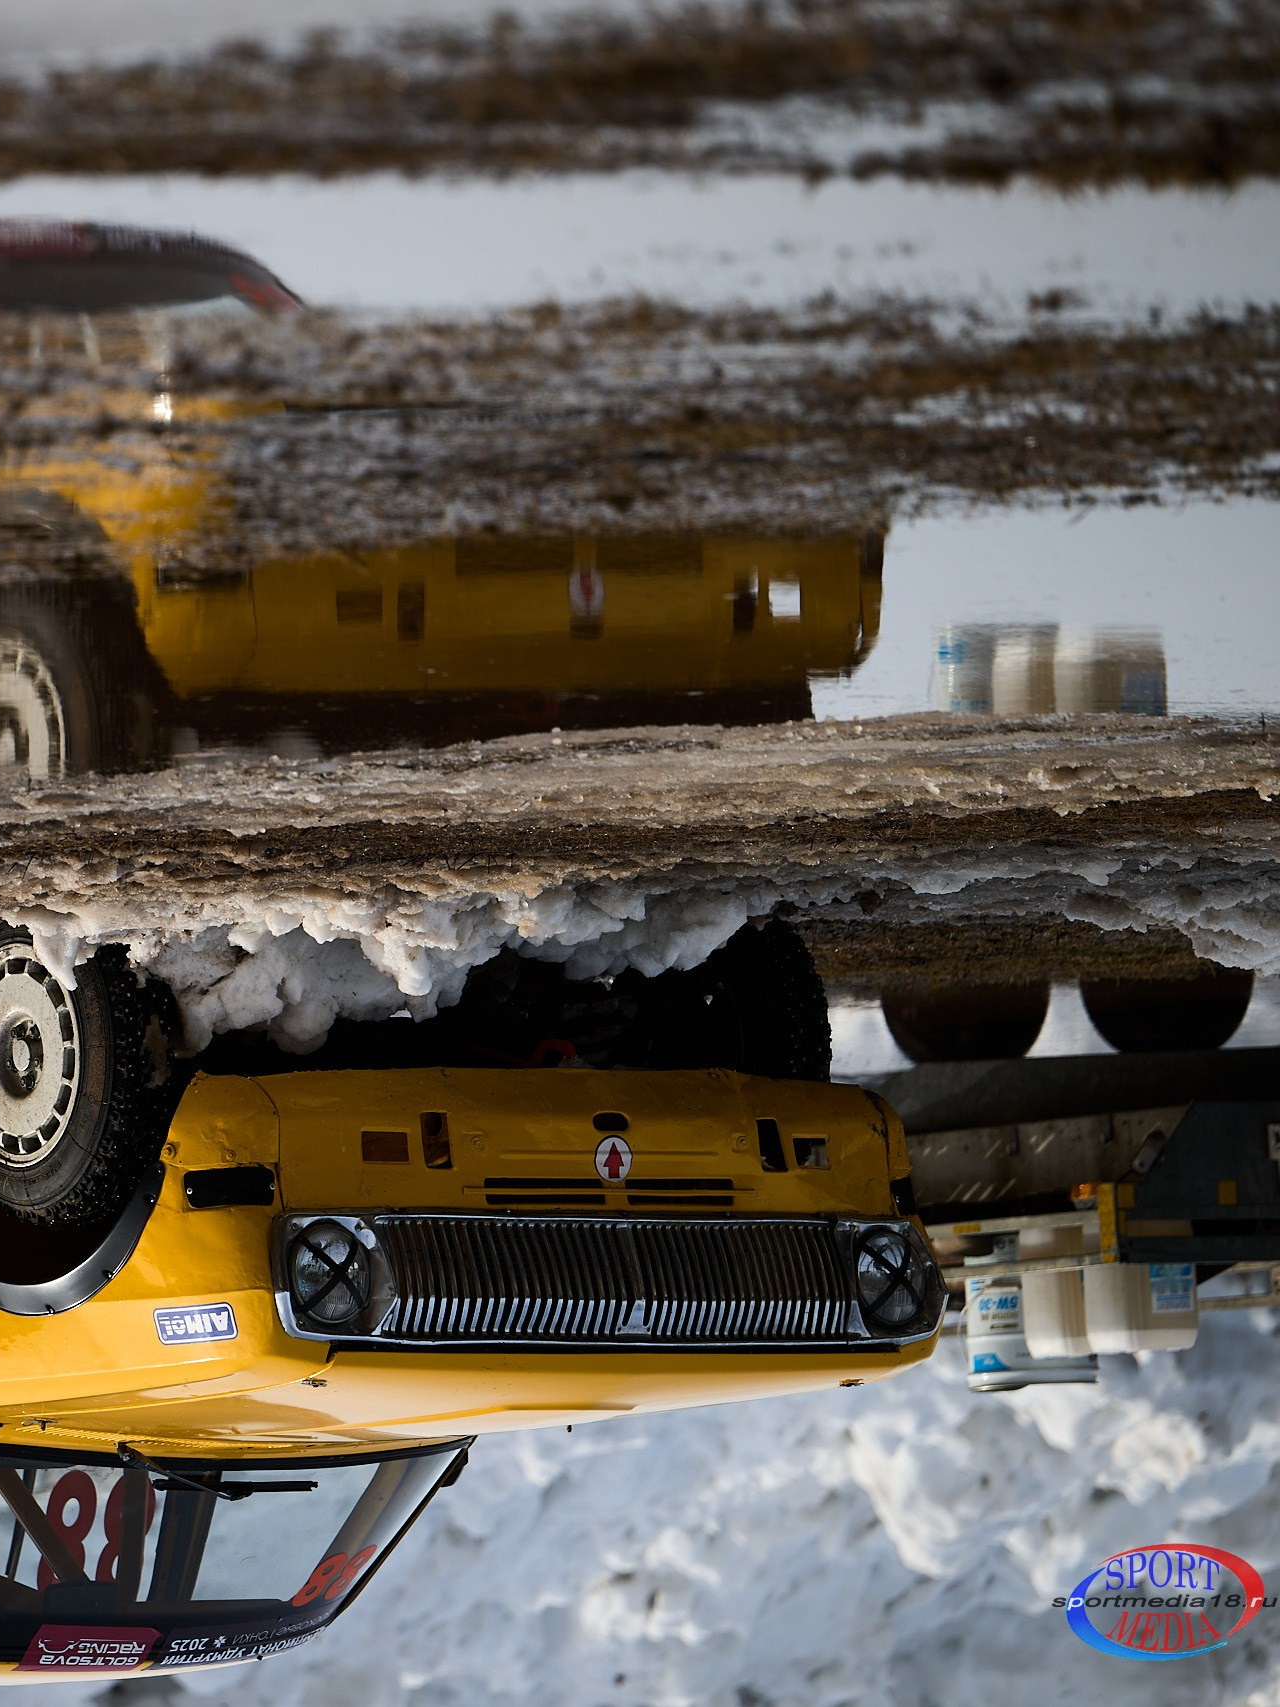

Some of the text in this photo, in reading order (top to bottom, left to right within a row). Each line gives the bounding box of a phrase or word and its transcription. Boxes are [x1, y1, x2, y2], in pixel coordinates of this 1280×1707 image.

[158, 1310, 228, 1336] AIMOL
[291, 1545, 377, 1607] 88
[78, 1641, 146, 1654] RACING
[169, 1638, 210, 1651] 2025
[39, 1655, 139, 1666] GOLTSOVA
[160, 1647, 246, 1665] УДМУРТИИ
